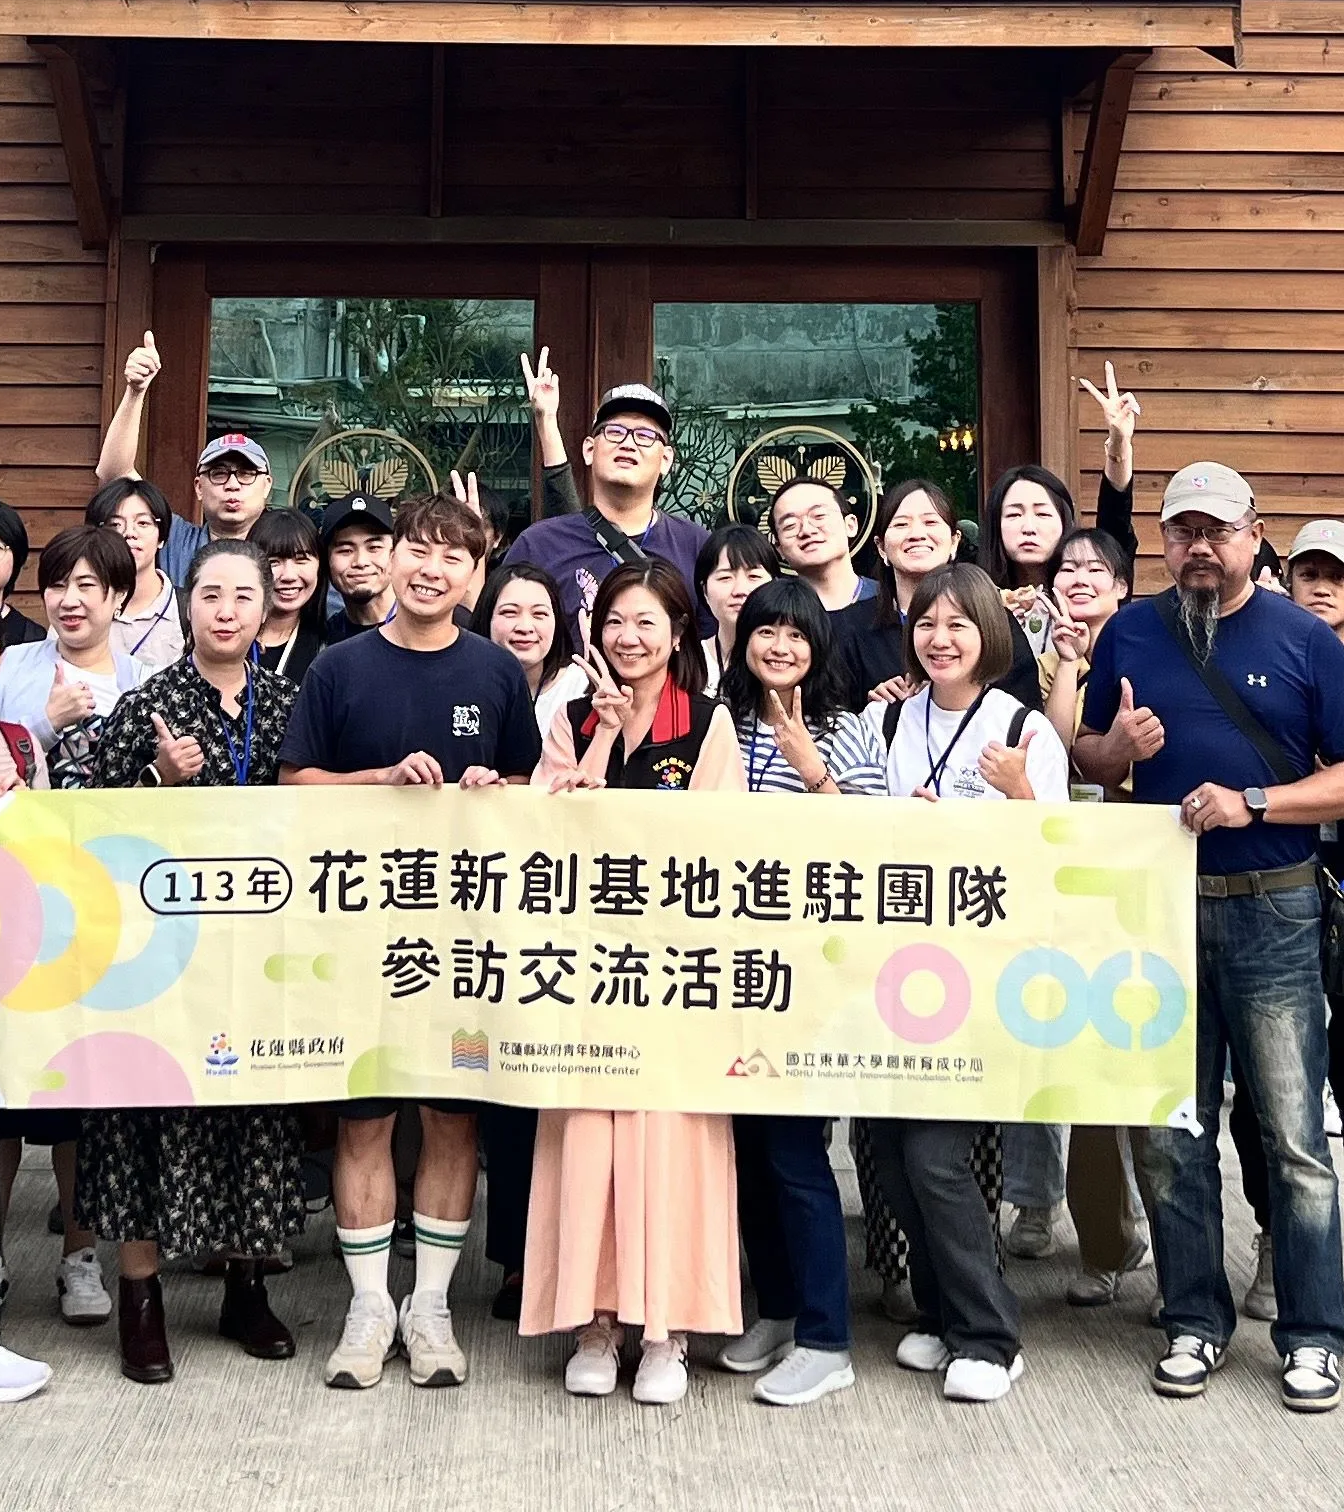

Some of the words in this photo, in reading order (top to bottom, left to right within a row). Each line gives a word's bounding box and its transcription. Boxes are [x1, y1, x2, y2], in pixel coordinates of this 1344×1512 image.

[163, 866, 282, 905] 113年
[308, 847, 1007, 928] 花蓮新創基地進駐團隊
[381, 936, 792, 1013] 參訪交流活動
[250, 1035, 345, 1058] 花蓮縣政府
[499, 1041, 641, 1060] 花蓮縣政府青年發展中心
[499, 1061, 529, 1073] Youth
[531, 1063, 601, 1075] Development
[604, 1065, 641, 1076] Center
[785, 1051, 984, 1073] 國立東華大學創新育成中心
[785, 1069, 814, 1078] NDHU
[817, 1069, 856, 1079] Industrial
[860, 1071, 904, 1081] Innovation
[954, 1073, 984, 1083] Center
